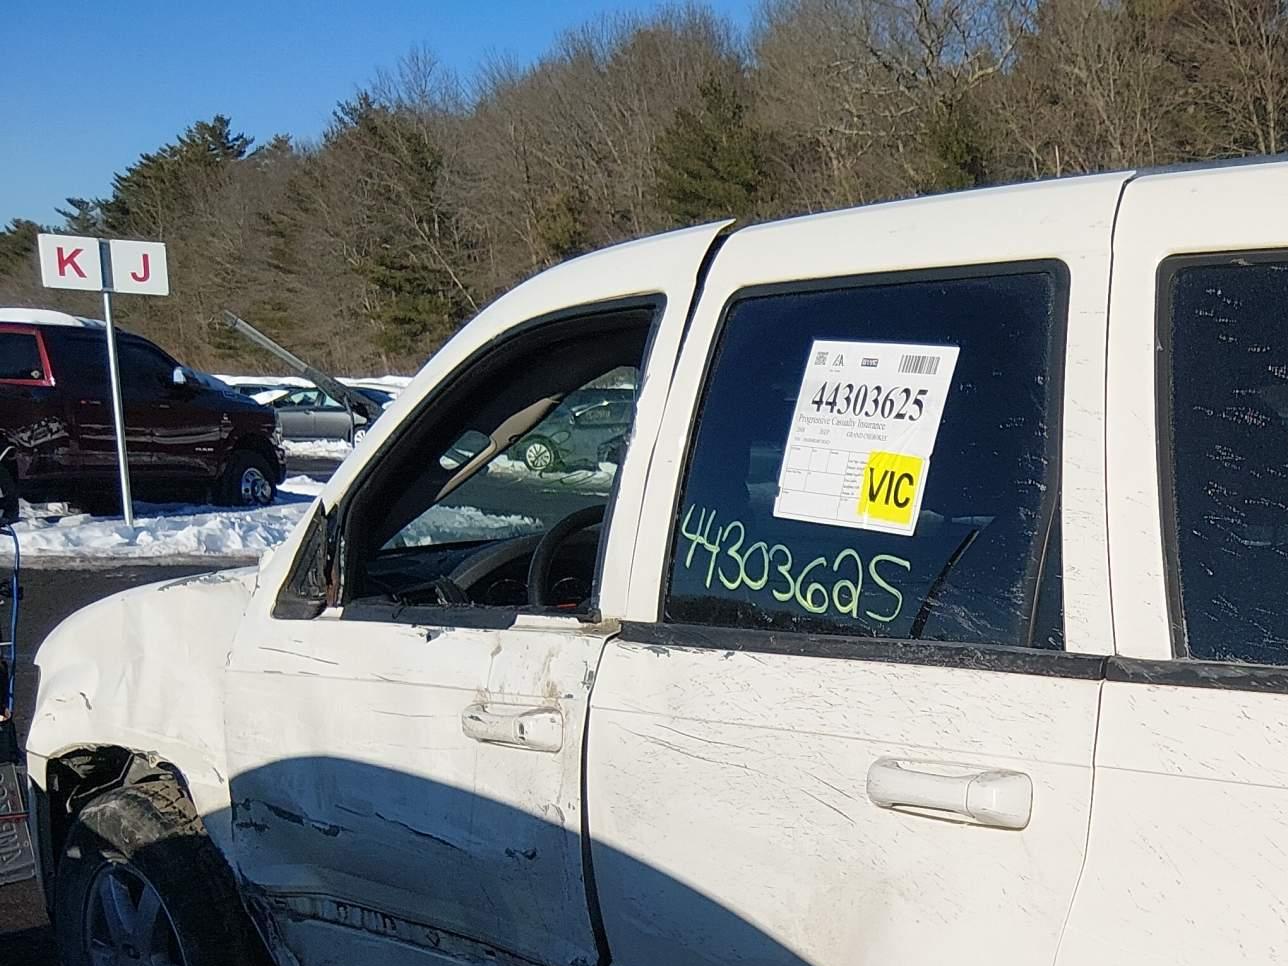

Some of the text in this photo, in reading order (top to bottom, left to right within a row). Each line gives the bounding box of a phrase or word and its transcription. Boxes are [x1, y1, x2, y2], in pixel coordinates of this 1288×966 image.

[56, 246, 88, 279] K
[131, 253, 151, 282] J
[811, 381, 928, 421] 44303625
[798, 413, 887, 431] Progressive Casualty Insurance
[868, 467, 914, 509] VIC
[681, 503, 911, 622] 44303625
